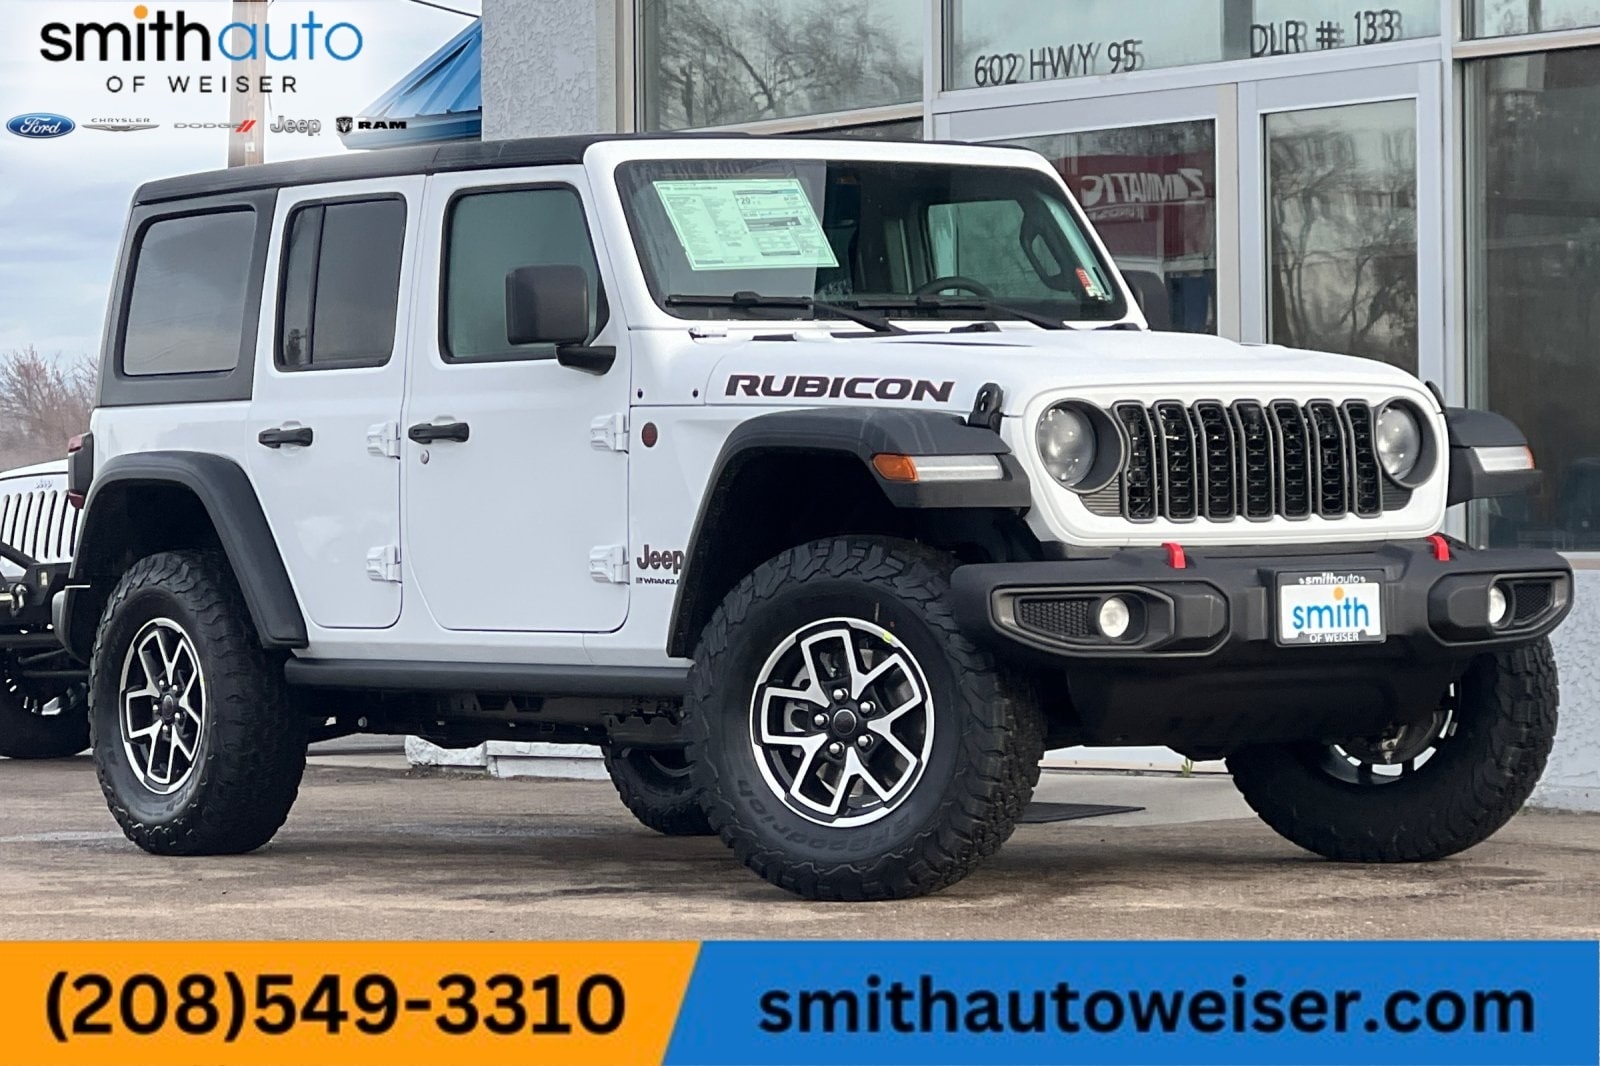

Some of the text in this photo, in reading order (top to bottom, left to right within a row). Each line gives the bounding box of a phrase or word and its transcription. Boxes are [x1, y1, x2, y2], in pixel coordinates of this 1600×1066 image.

[1250, 9, 1395, 57] DLR # 133
[975, 39, 1138, 87] 602 HWY 95
[725, 374, 955, 402] RUBICON
[636, 544, 685, 575] Jeep
[1305, 573, 1360, 585] smithauto
[1292, 587, 1369, 629] smith
[1309, 632, 1360, 643] OF WEISER
